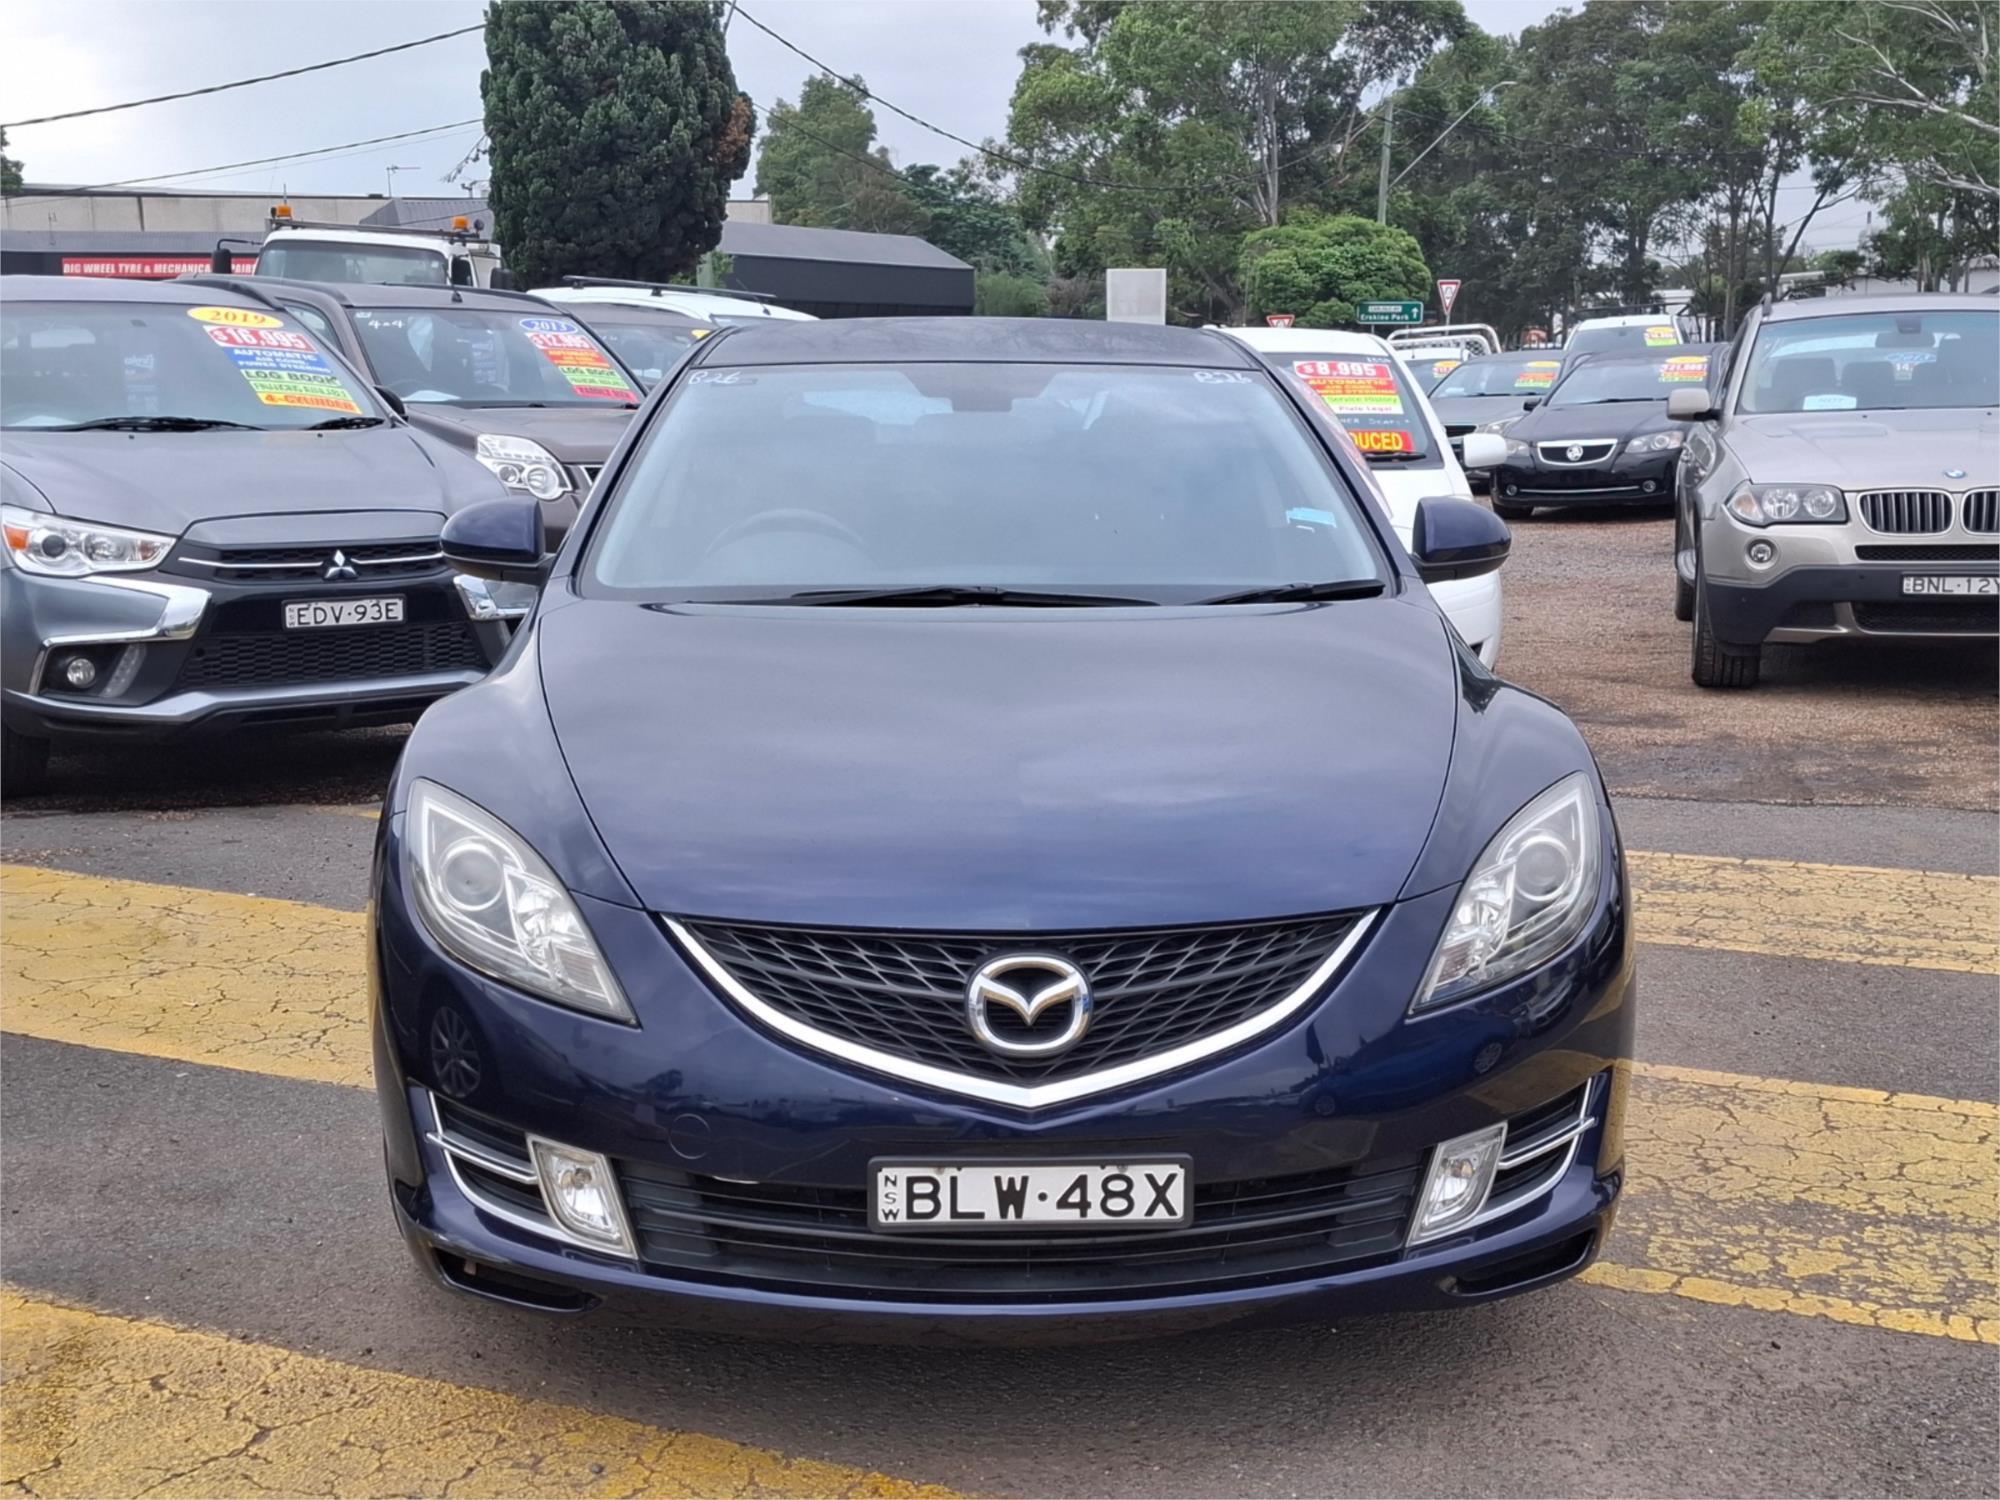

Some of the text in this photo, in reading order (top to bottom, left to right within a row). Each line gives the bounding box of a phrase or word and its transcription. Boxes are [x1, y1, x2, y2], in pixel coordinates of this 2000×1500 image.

[63, 263, 82, 274] BIG
[84, 263, 116, 274] WHEEL
[118, 263, 142, 274] TYRE
[153, 263, 211, 274] MECHANICA
[210, 310, 266, 324] 2019
[212, 328, 307, 350] $16,995
[233, 348, 318, 361] AUTOMATIC
[1303, 361, 1377, 376] $8,995
[244, 369, 338, 385] LOG BOOK
[264, 394, 355, 412] 4-CYLINDER
[882, 1174, 900, 1222] NSW
